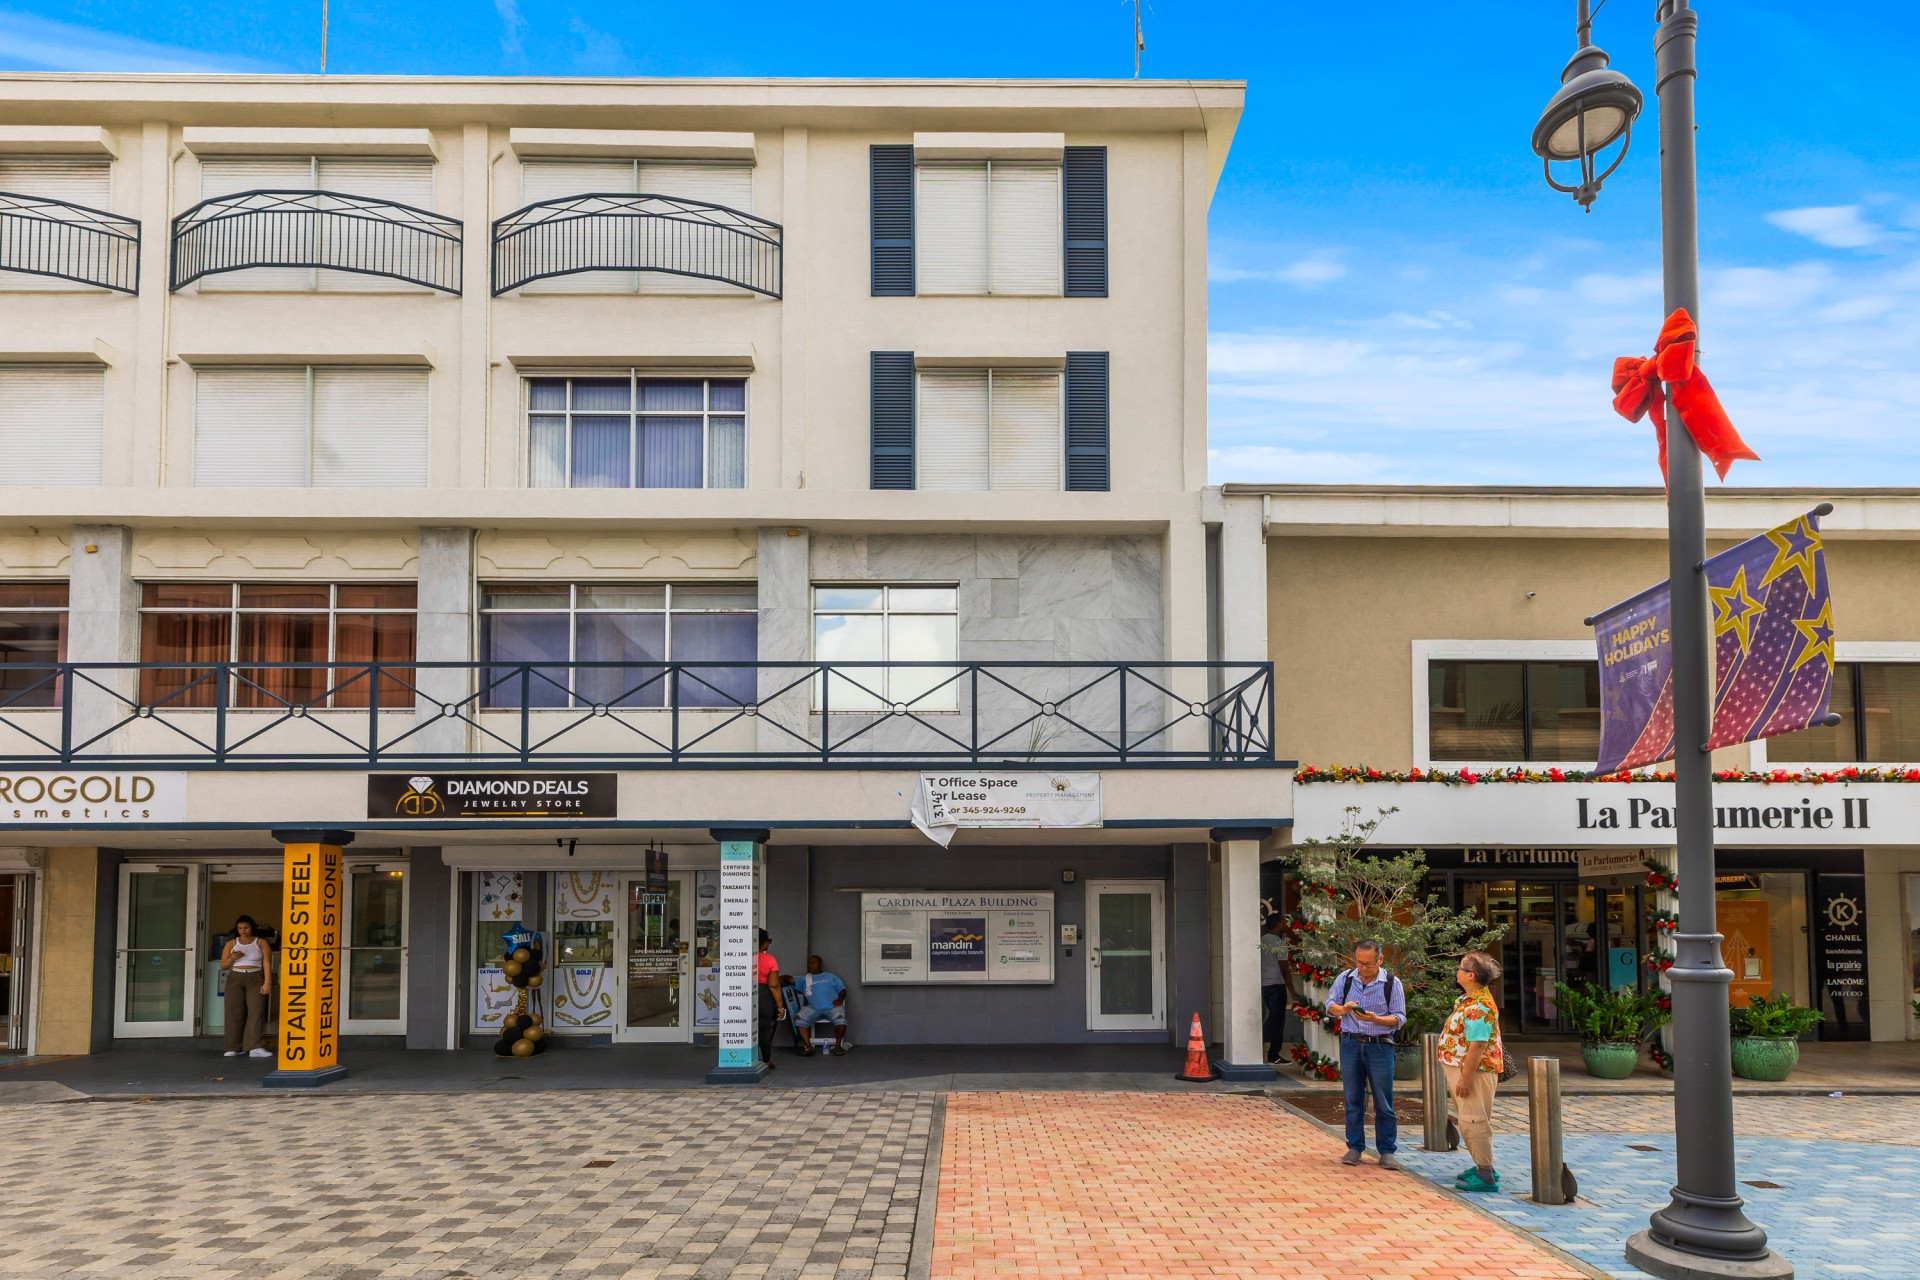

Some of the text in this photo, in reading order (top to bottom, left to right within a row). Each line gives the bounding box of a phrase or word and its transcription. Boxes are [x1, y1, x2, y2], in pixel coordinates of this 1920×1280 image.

[1612, 616, 1657, 647] HAPPY
[1604, 629, 1670, 667] HOLIDAYS
[0, 776, 155, 803] ROGOLD
[447, 781, 588, 795] DIAMOND DEALS
[938, 777, 976, 787] Office
[979, 778, 1018, 789] Space
[951, 791, 987, 800] Lease
[1576, 798, 1871, 829] La Paumerie II
[1463, 849, 1488, 863] La
[1583, 857, 1593, 866] La
[1593, 852, 1637, 866] Parfumerie
[643, 894, 665, 904] OPEN
[877, 897, 1038, 908] CARDINAL PLAZA BUILDING
[931, 940, 973, 950] mandiri
[286, 853, 311, 1062] STAINLESS STEEL
[319, 853, 336, 1057] STERLING & STONE
[1621, 952, 1633, 965] G
[1827, 960, 1862, 972] la prairie
[1827, 977, 1864, 985] LANCÔME
